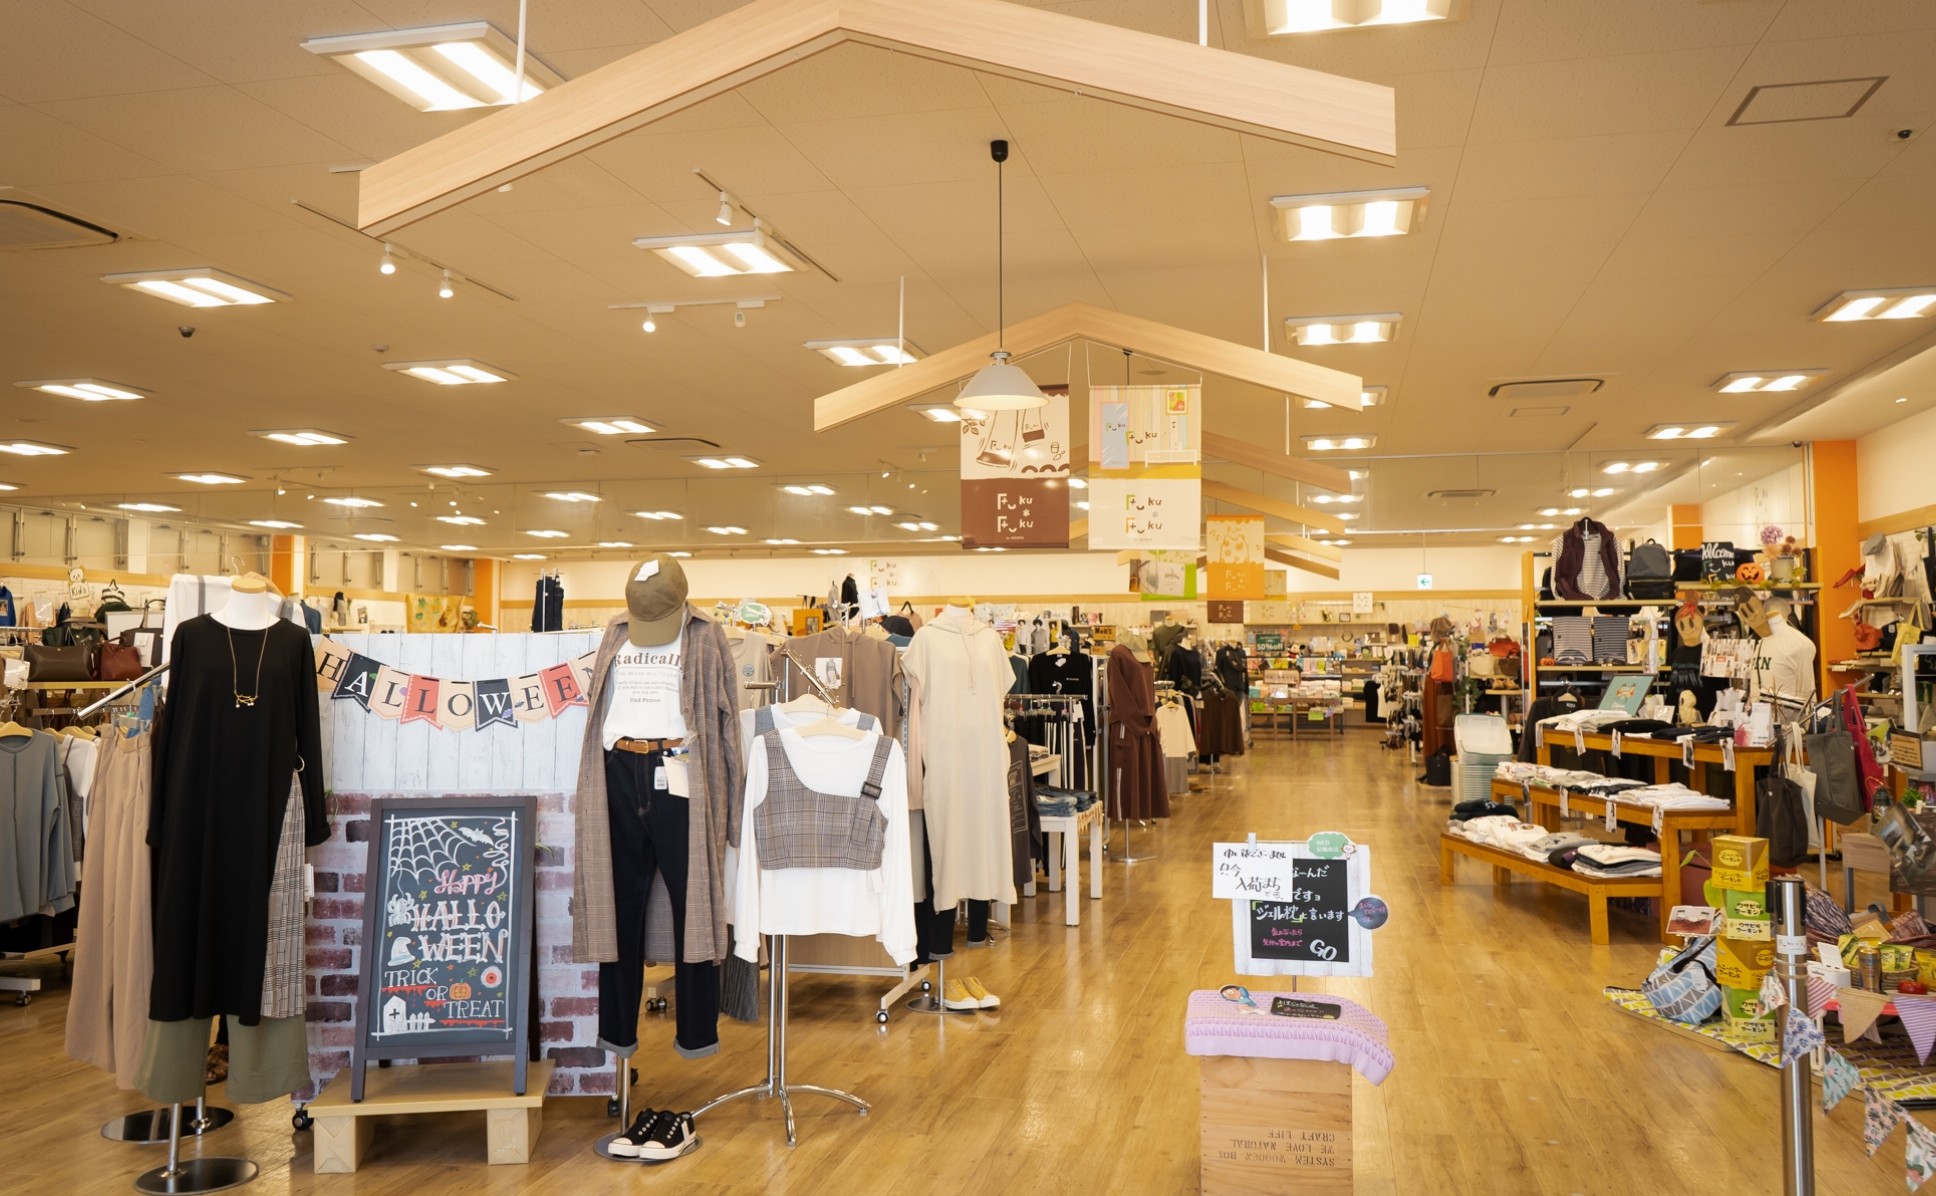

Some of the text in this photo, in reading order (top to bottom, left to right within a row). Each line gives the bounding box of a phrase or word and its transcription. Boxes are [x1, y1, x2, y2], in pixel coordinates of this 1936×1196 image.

[411, 899, 504, 932] HALLO
[418, 930, 508, 963] WEEN
[1309, 939, 1338, 961] GO
[385, 968, 438, 987] TRICK
[425, 985, 449, 1001] OR
[443, 1000, 504, 1018] TREAT
[1268, 1129, 1335, 1142] CRAFT LIFE
[1230, 1139, 1277, 1151] NATURAL
[1286, 1143, 1312, 1153] LOVE
[1295, 1155, 1335, 1167] SYSTEM
